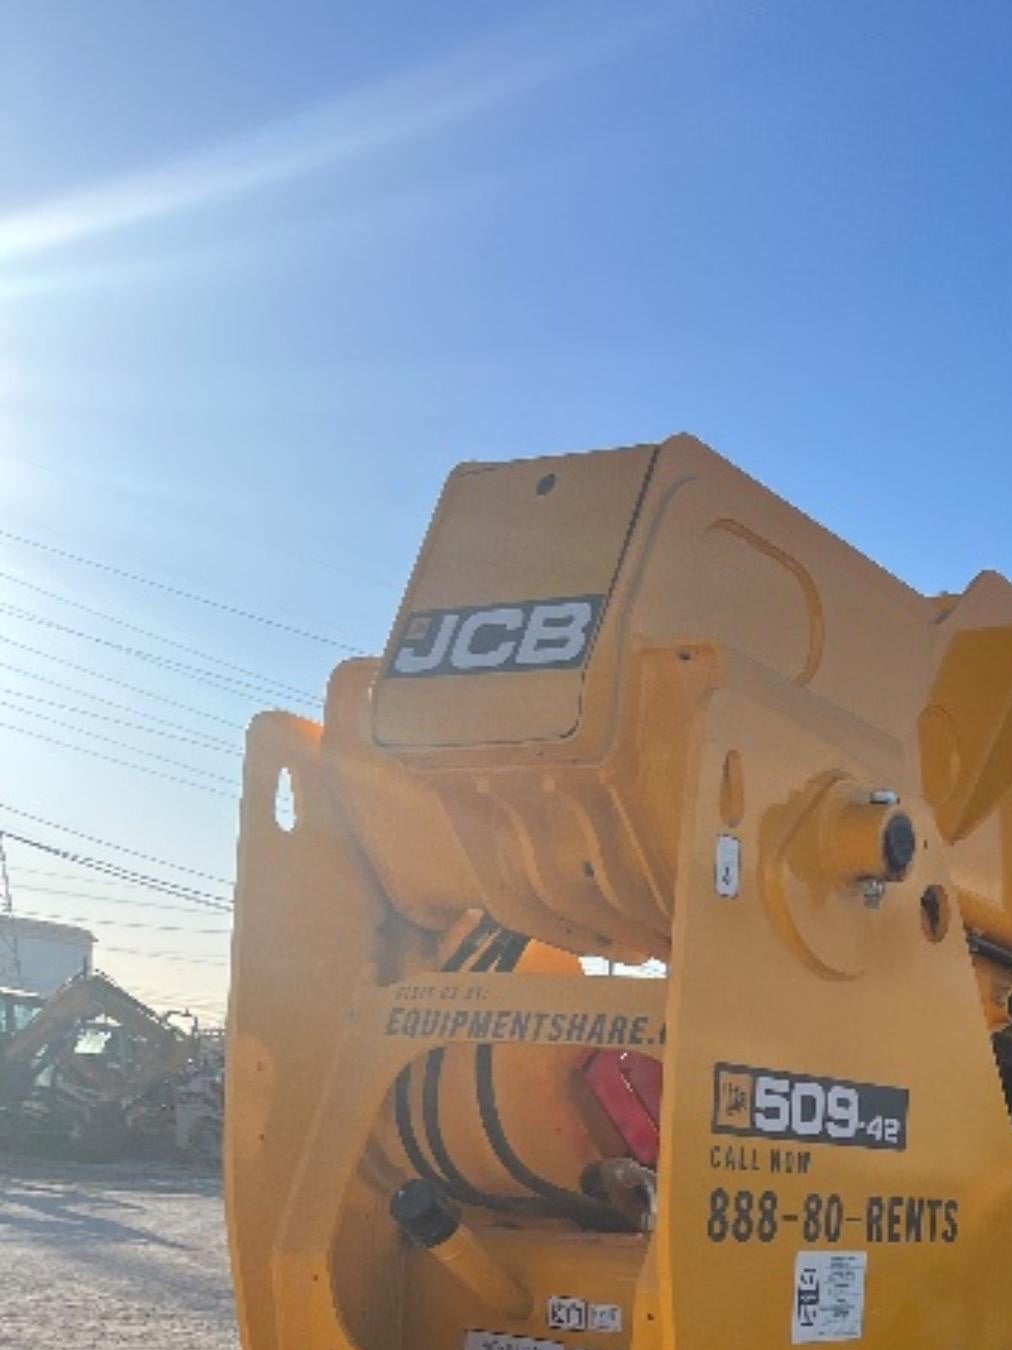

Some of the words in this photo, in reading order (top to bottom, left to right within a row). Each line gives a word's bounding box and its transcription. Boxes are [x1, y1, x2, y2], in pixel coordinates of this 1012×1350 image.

[394, 602, 592, 673] JCB
[710, 1145, 760, 1171] CALL
[770, 1149, 812, 1174] NOW
[707, 1187, 958, 1243] 888-80-RENTS
